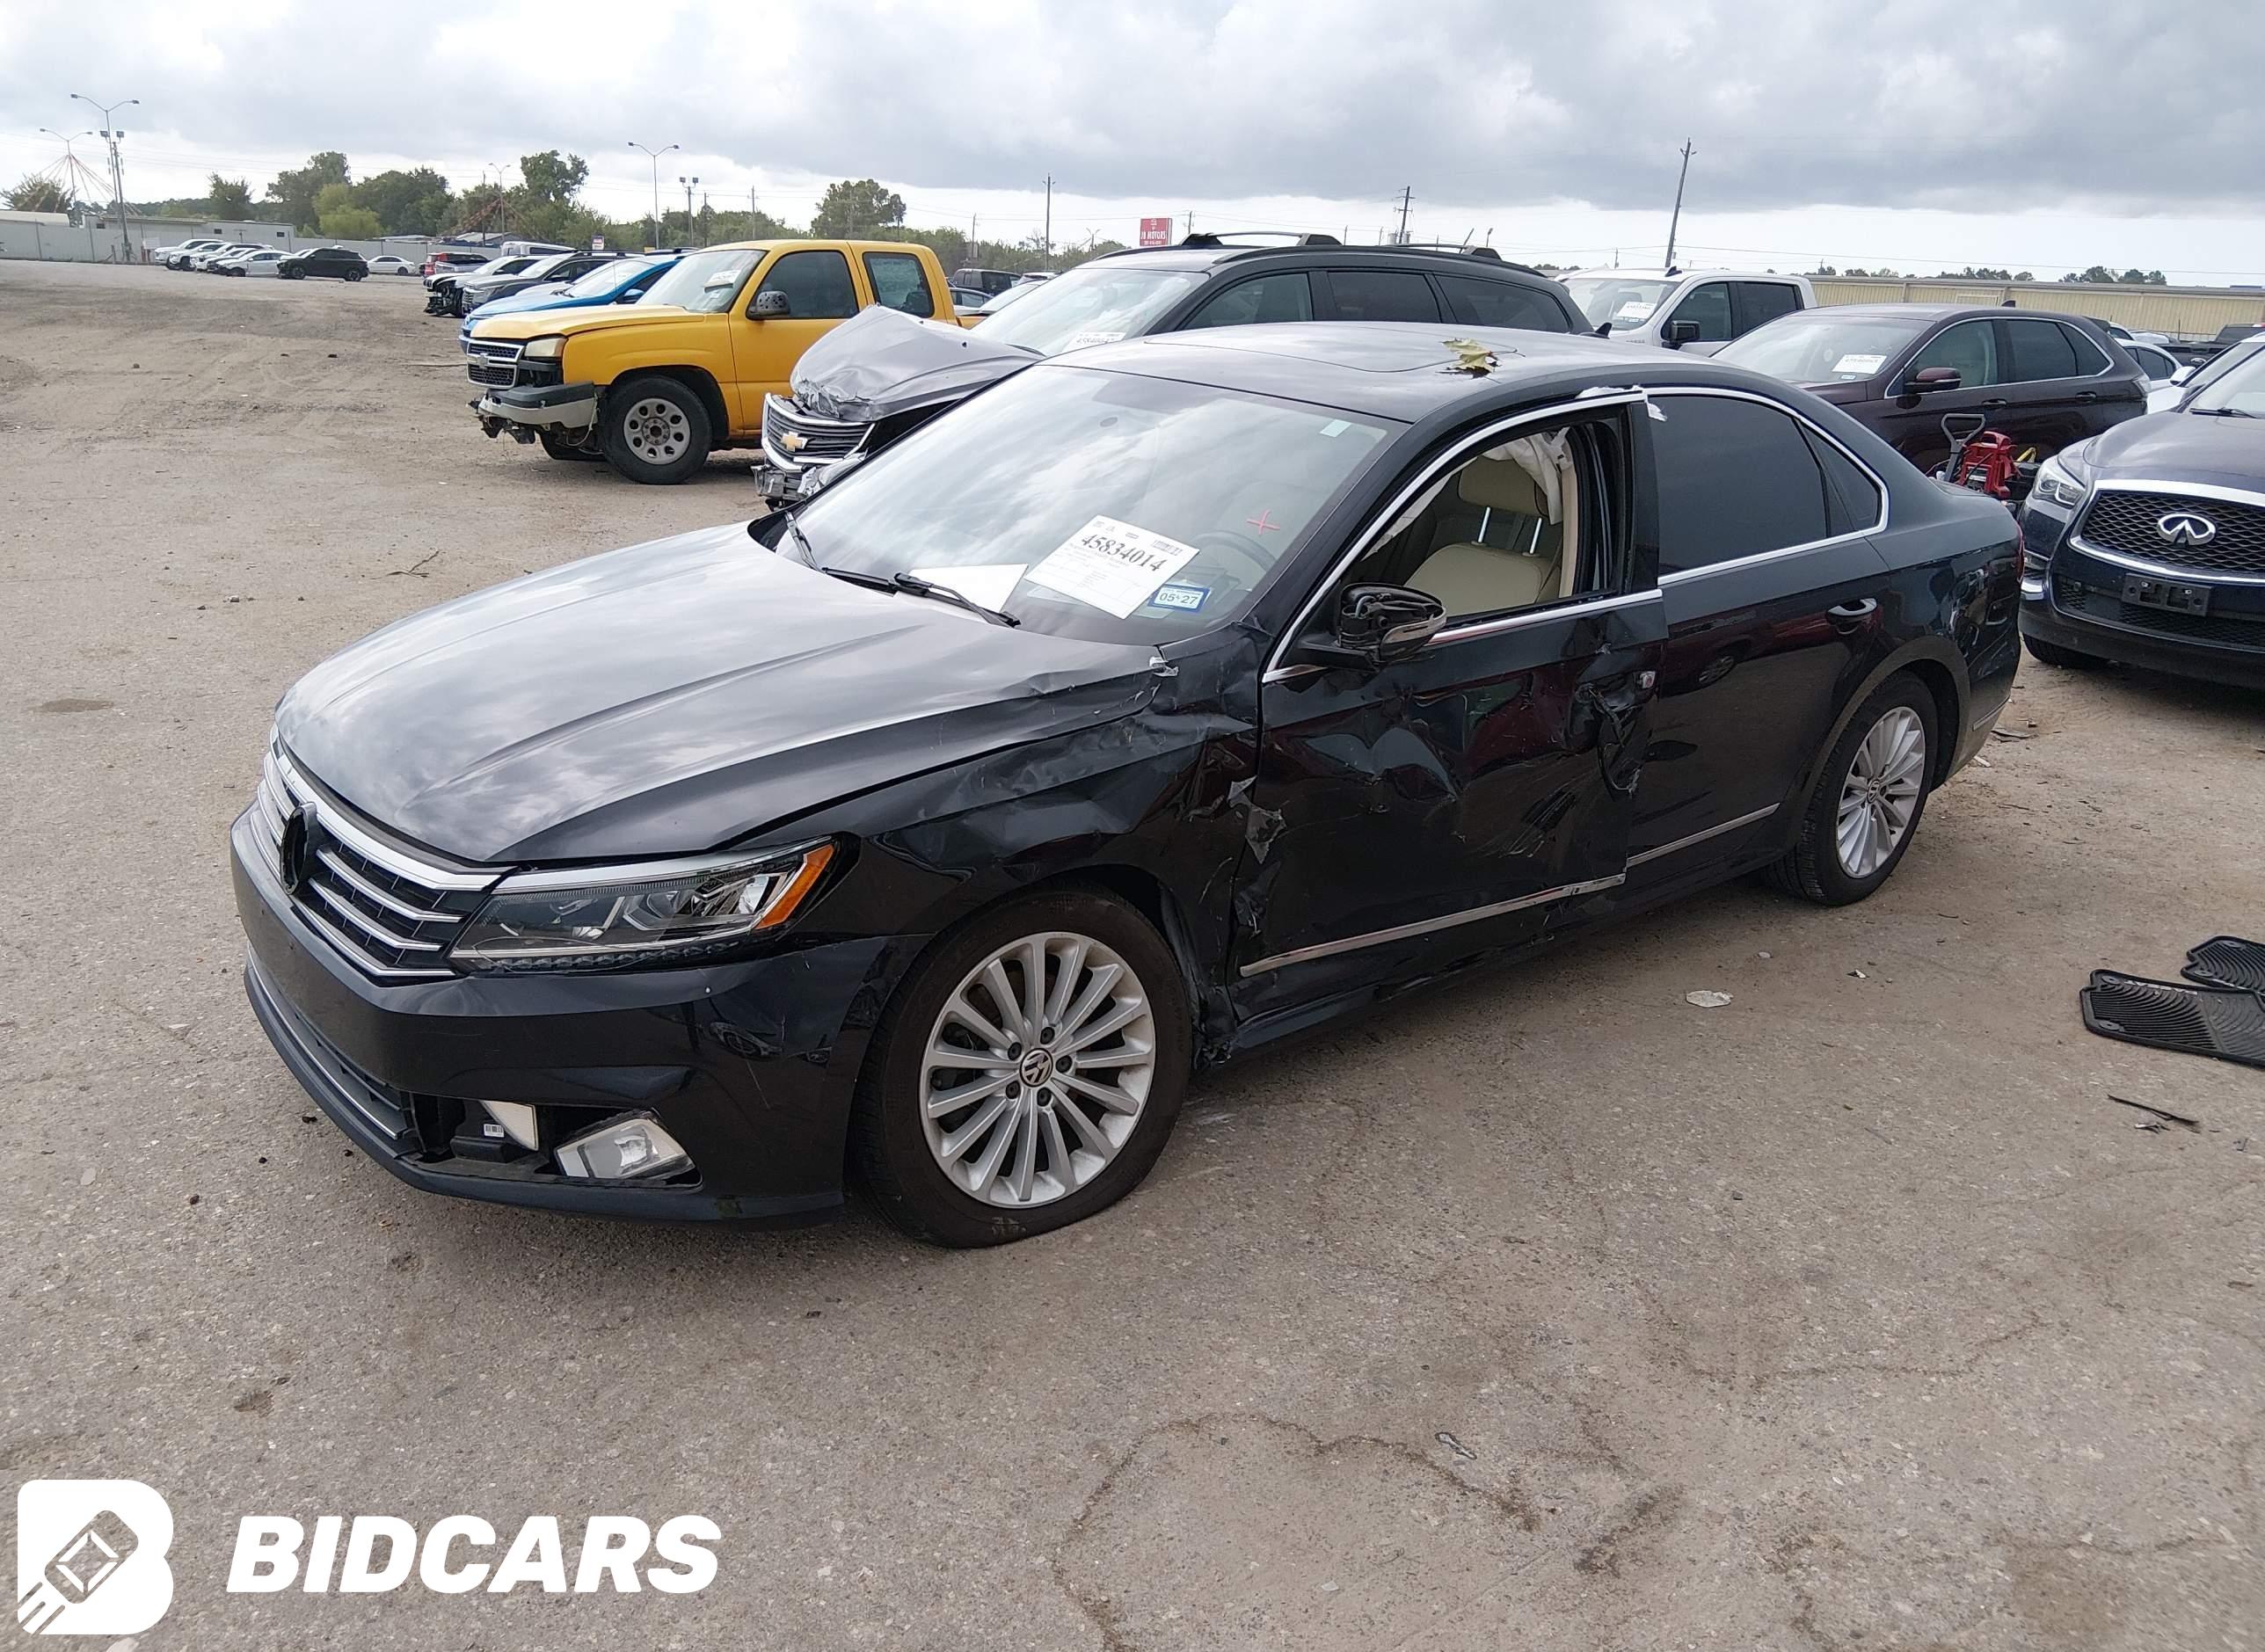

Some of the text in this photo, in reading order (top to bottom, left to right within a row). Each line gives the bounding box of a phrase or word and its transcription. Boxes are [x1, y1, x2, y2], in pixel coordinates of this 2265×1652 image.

[1147, 230, 1166, 239] MOTORS
[1082, 534, 1168, 571] 45834014
[1159, 593, 1176, 601] 05
[1180, 594, 1198, 605] 27
